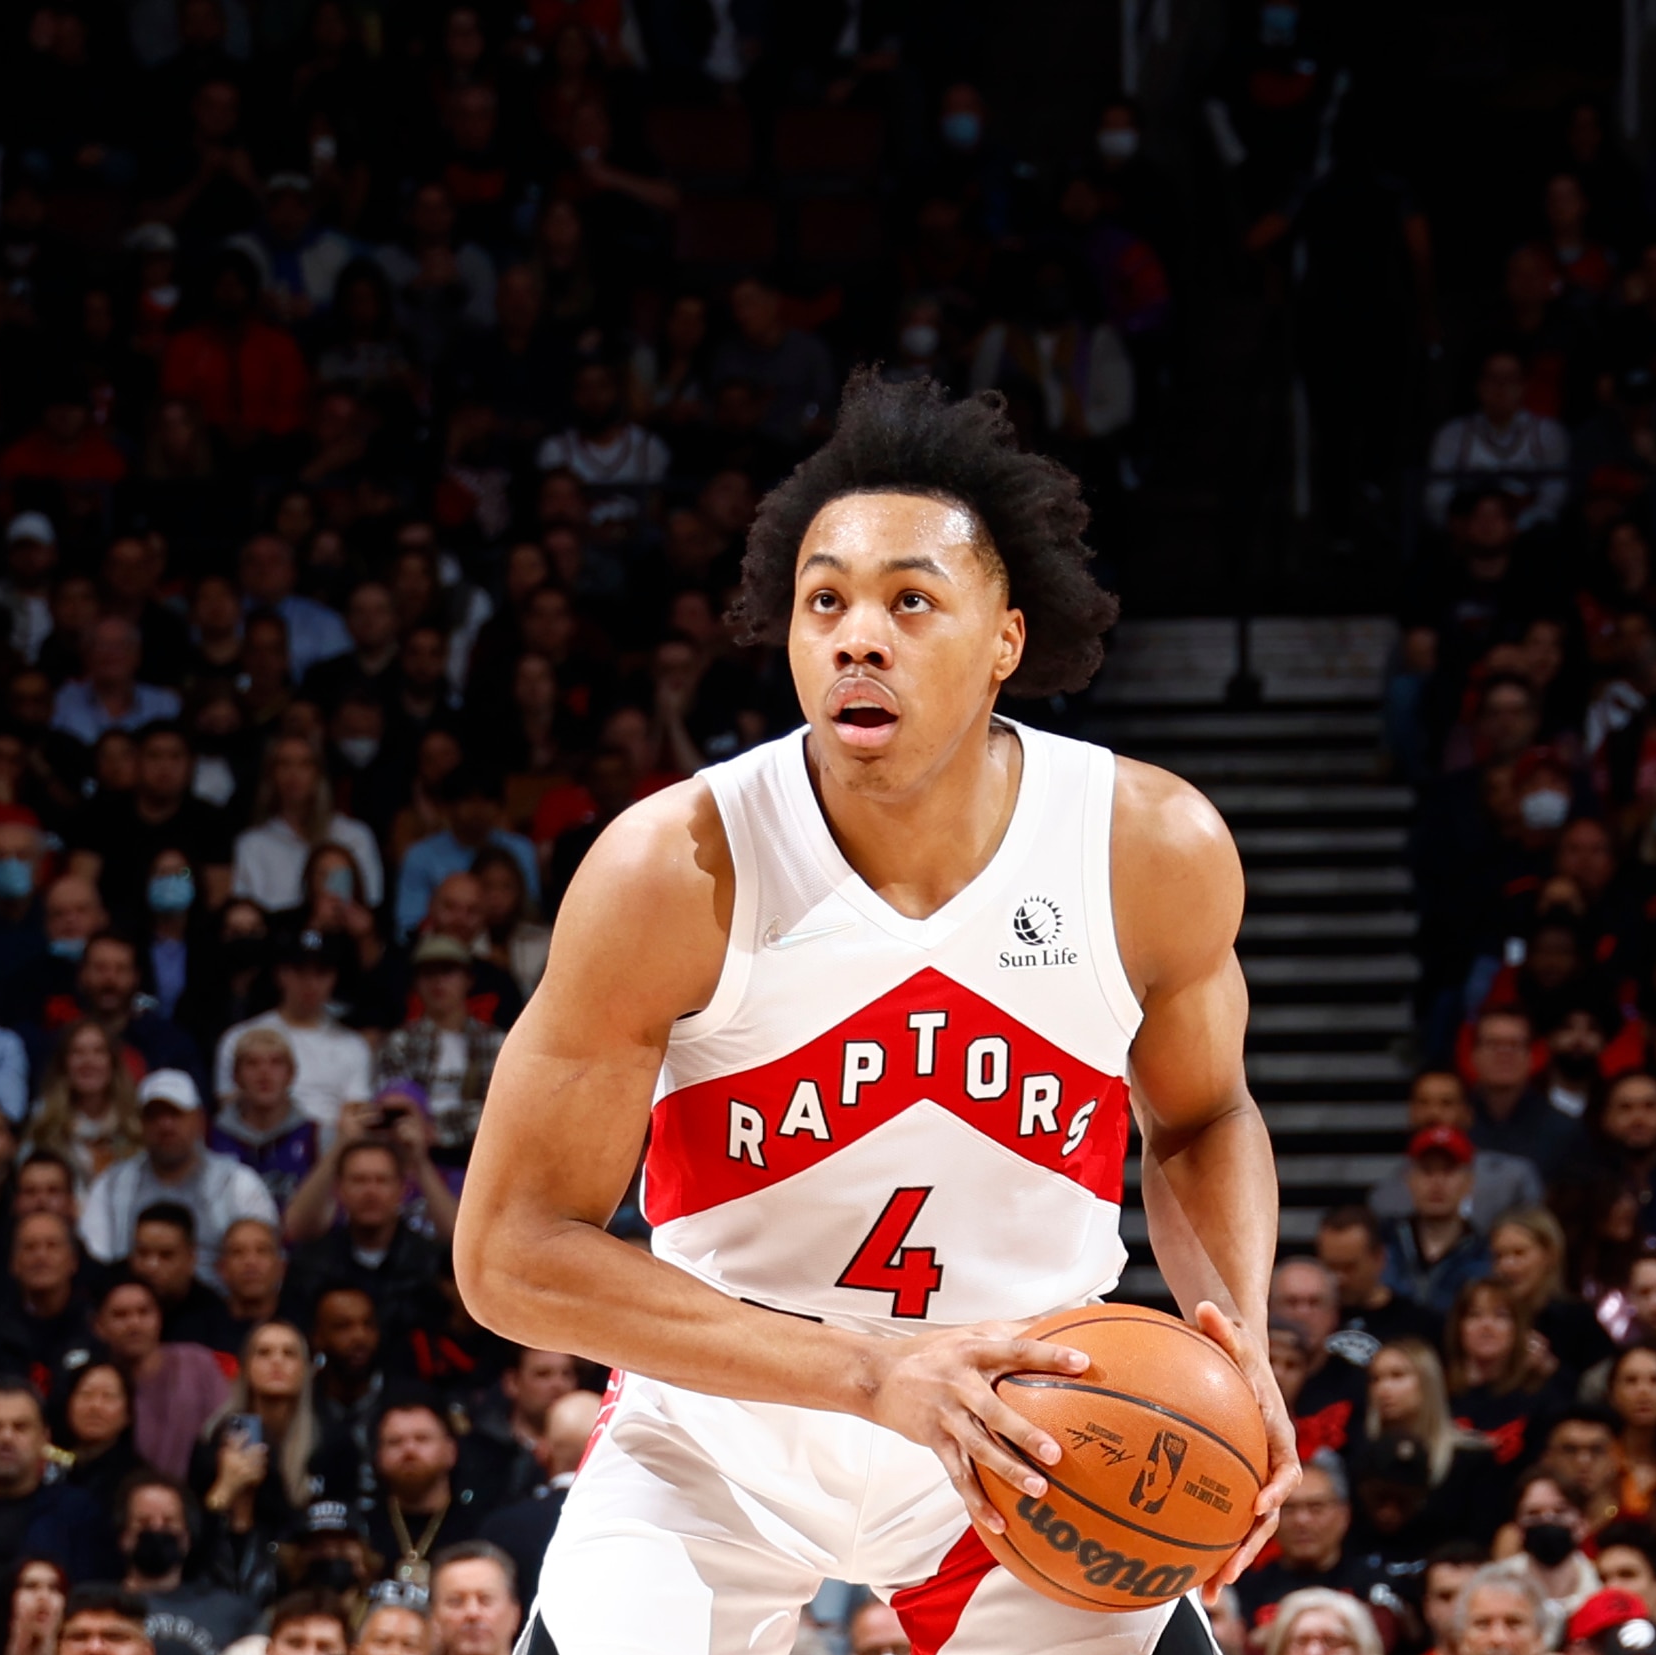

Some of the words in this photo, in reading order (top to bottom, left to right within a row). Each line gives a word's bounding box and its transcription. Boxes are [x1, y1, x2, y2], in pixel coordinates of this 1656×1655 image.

[998, 951, 1037, 968] Sun
[1042, 947, 1078, 966] Life
[728, 1010, 1097, 1168] RAPTORS
[835, 1186, 943, 1319] 4
[1016, 1494, 1197, 1597] Wilson
